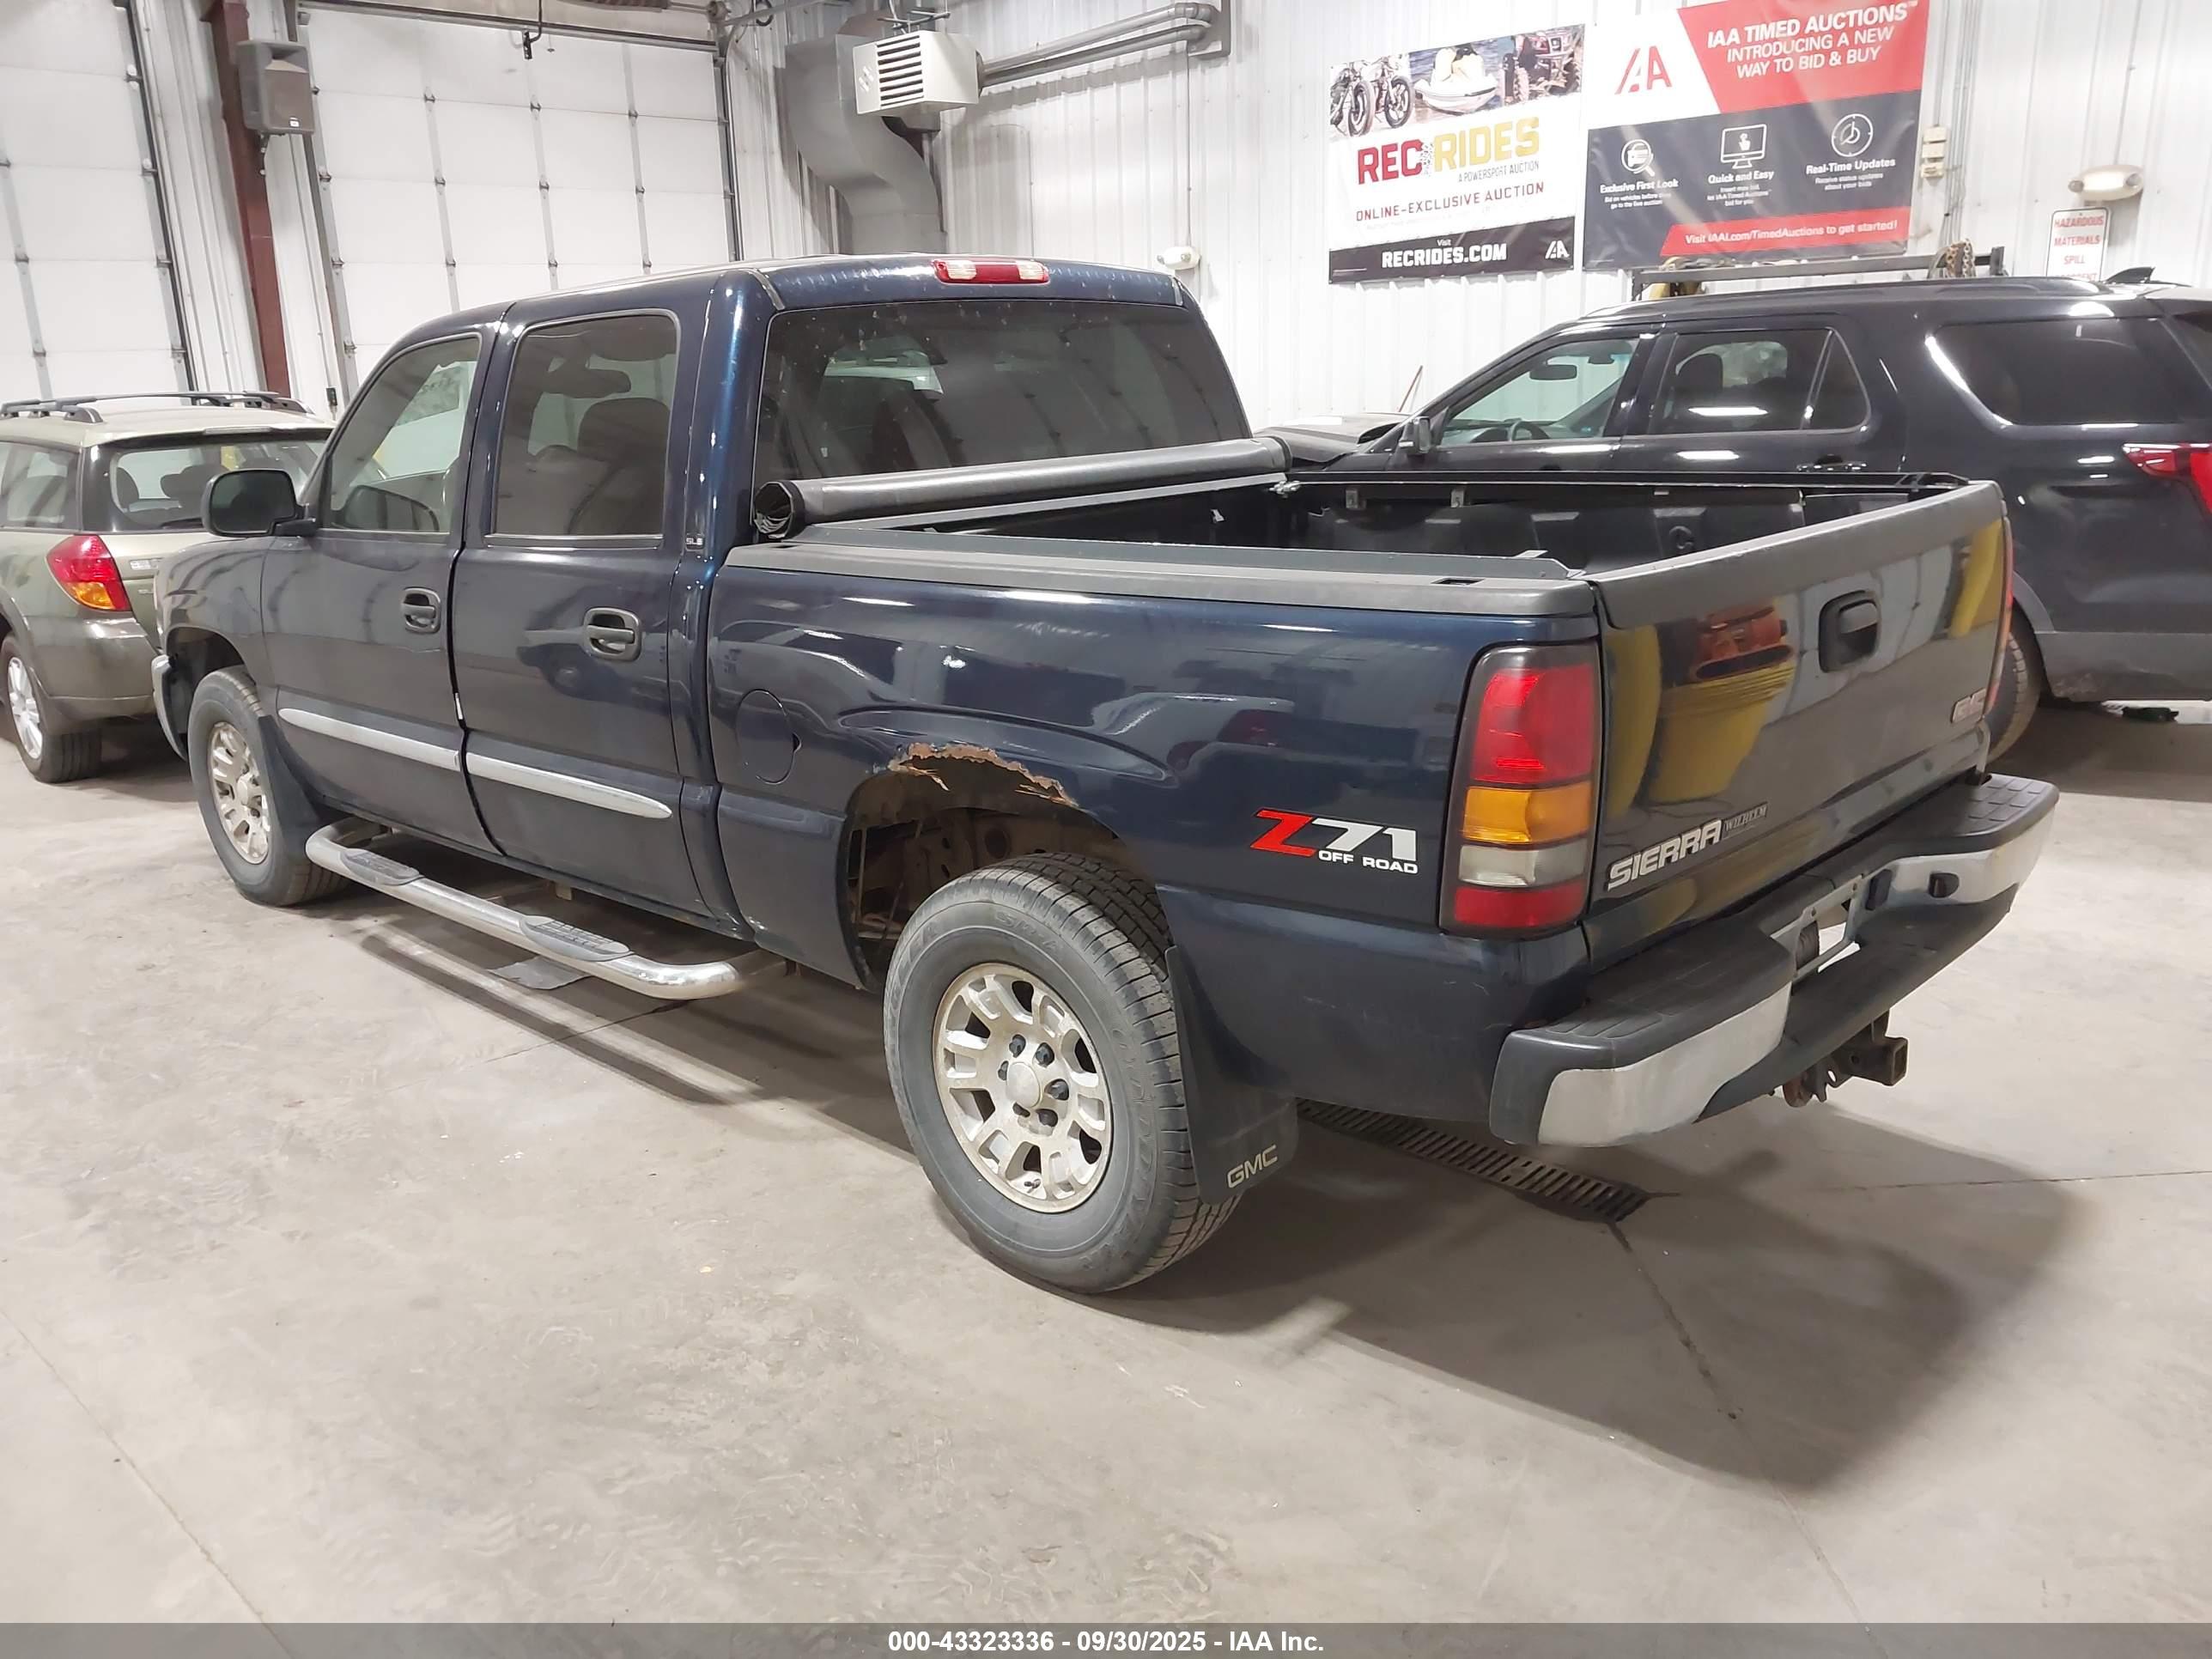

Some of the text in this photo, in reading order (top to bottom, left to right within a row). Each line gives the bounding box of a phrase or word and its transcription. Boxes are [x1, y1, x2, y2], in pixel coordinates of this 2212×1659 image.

[1707, 31, 1741, 48] IAA
[1744, 18, 1801, 43] TIMED
[1727, 26, 1895, 63] INTRODUCING A NEW
[1736, 46, 1881, 79] WAY TO BID & BUY
[1358, 117, 1540, 185] REC RIDES
[1510, 161, 1540, 174] AUCTION
[1708, 171, 1774, 184] Quick and Easy
[1806, 159, 1896, 174] Real-Time Updates
[1600, 179, 1679, 193] Exclusive First Look
[1356, 181, 1545, 222] ONLINE-EXCLUSIVE AUCTION
[1686, 234, 1705, 244] Visit
[1826, 225, 1837, 234] to
[1838, 224, 1856, 235] get
[1857, 220, 1898, 233] started!
[2054, 216, 2104, 228] HAZARDOUS
[2054, 234, 2100, 246] MATERIALS
[1382, 243, 1507, 269] RECRIDES.COM
[2063, 254, 2085, 264] SPILL
[1249, 809, 1417, 861] Z71
[1318, 850, 1419, 874] OFF ROAD
[1607, 819, 1723, 891] SIERRA
[1227, 1144, 1279, 1188] GMC
